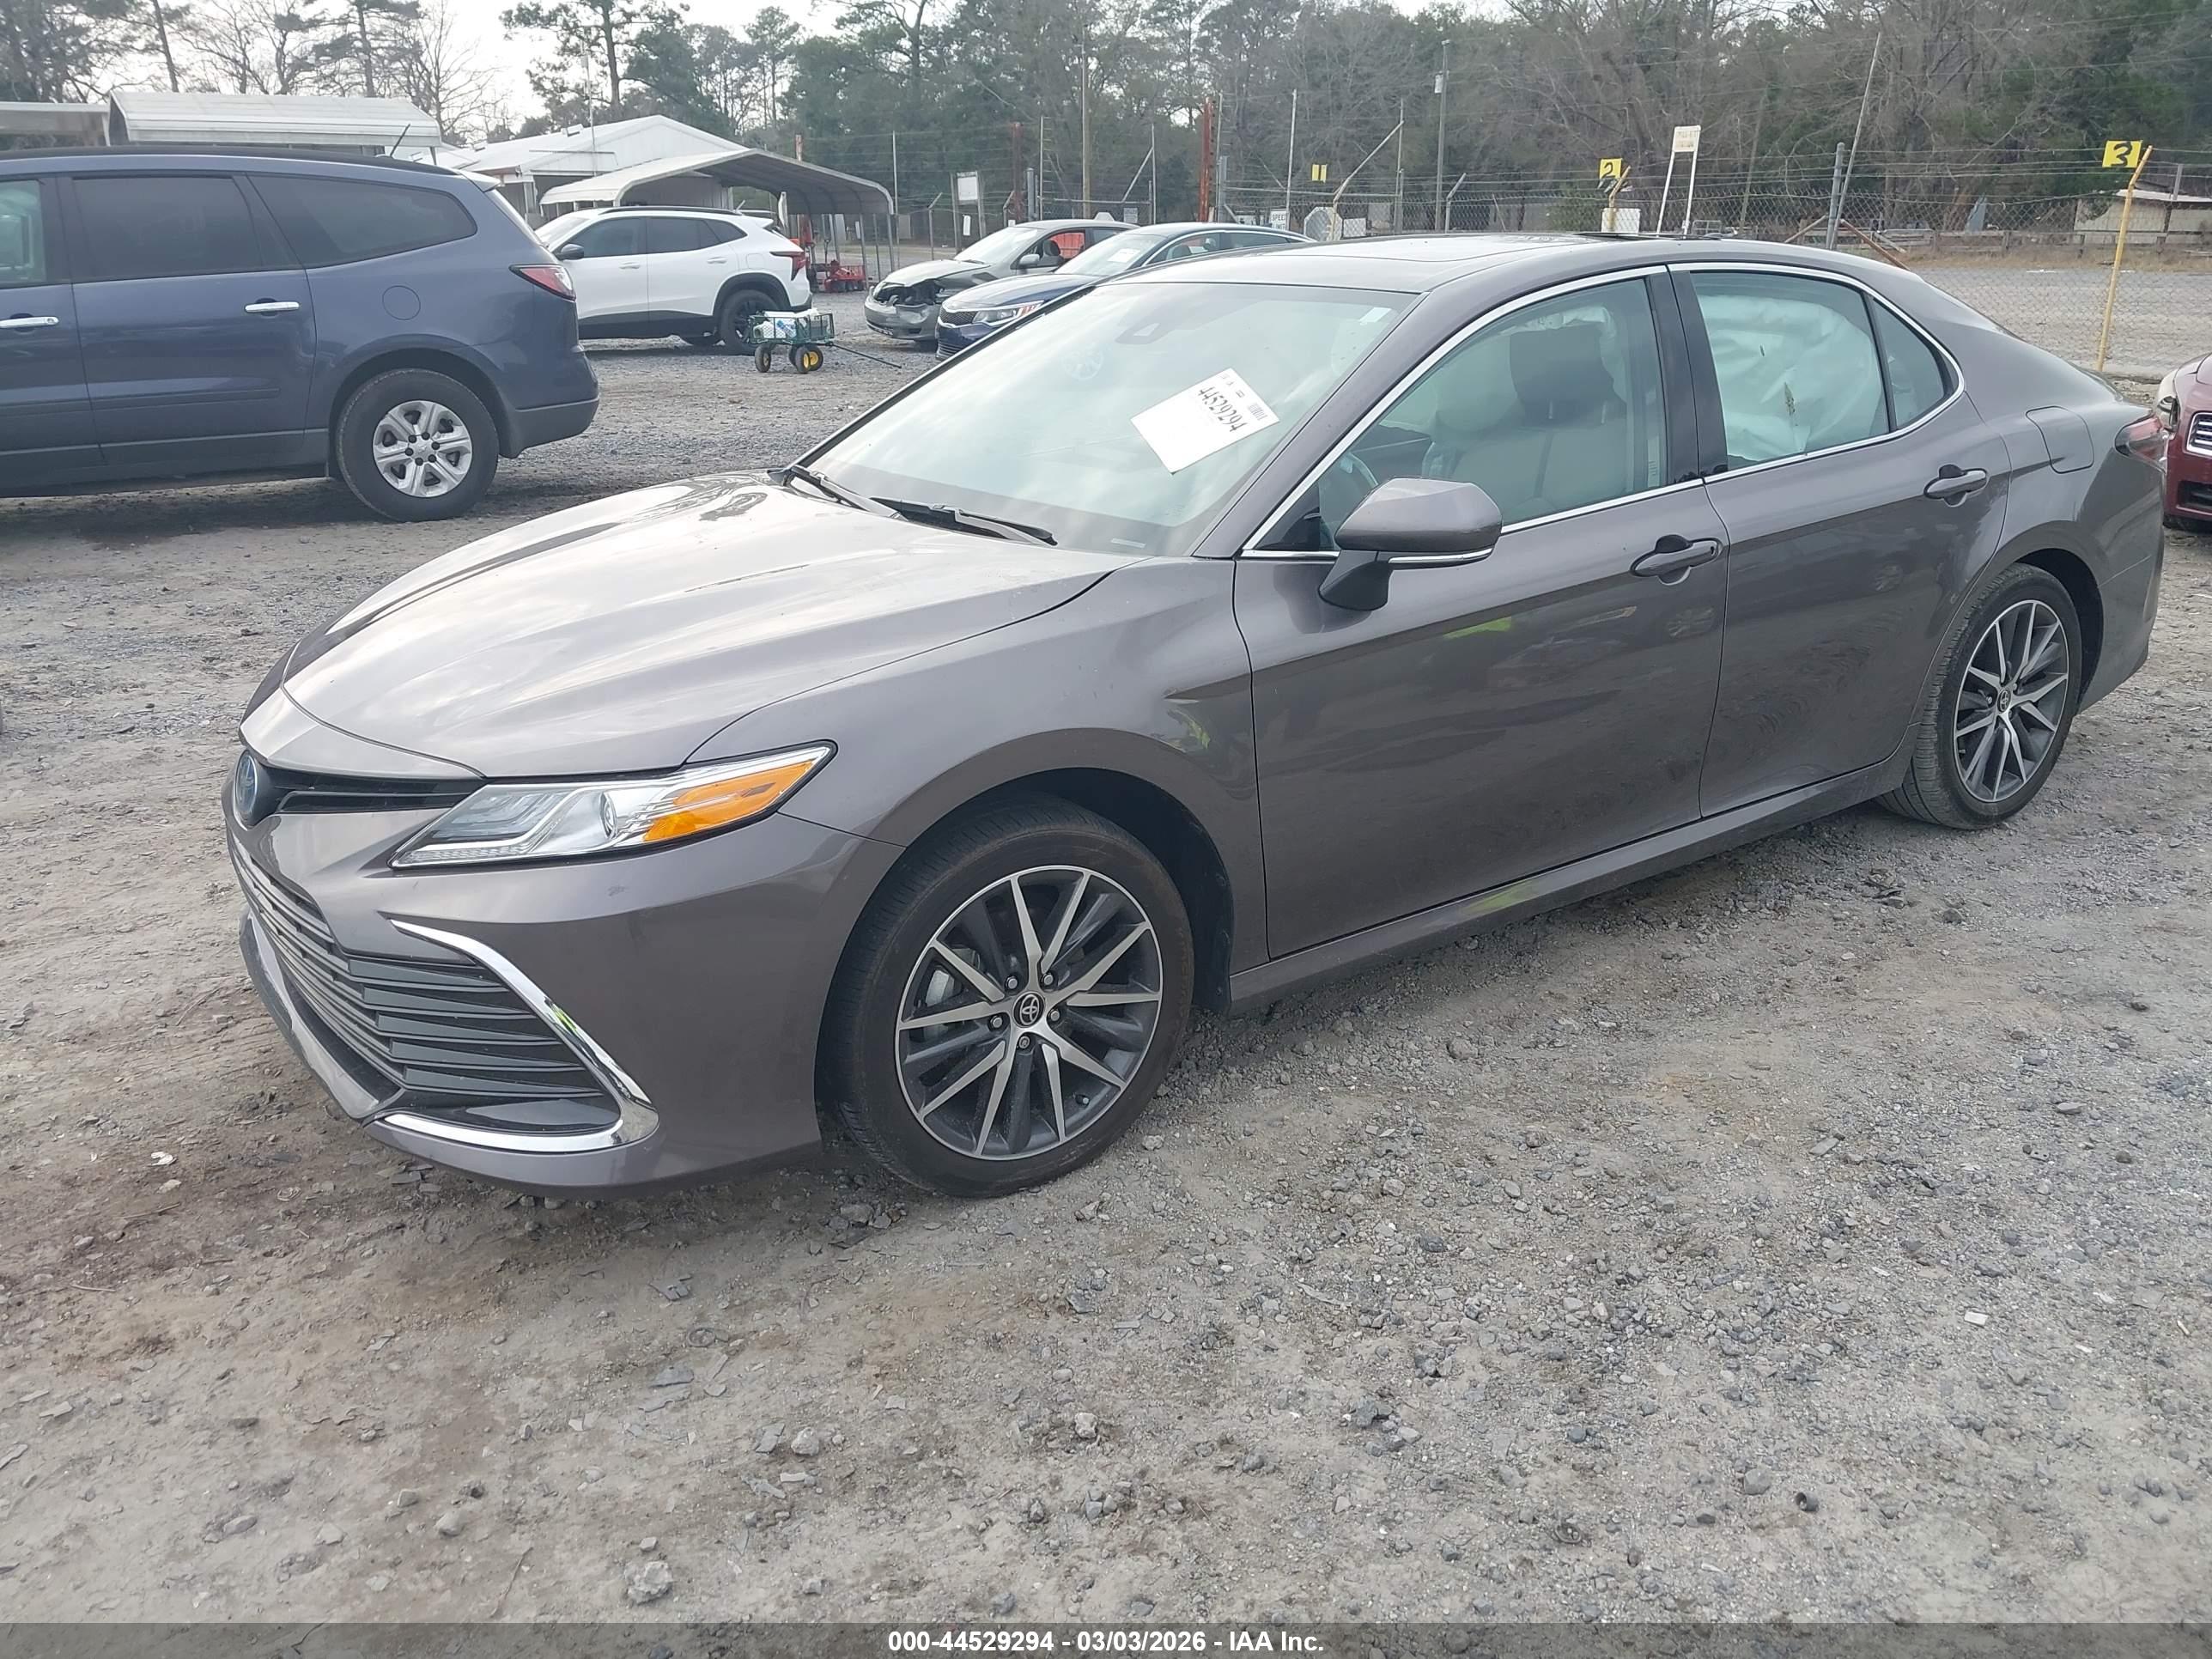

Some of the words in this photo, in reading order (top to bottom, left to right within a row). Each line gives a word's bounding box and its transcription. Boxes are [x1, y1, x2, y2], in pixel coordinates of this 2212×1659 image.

[2112, 141, 2132, 167] 3
[1601, 161, 1615, 179] 2
[1198, 386, 1248, 432] 44529294
